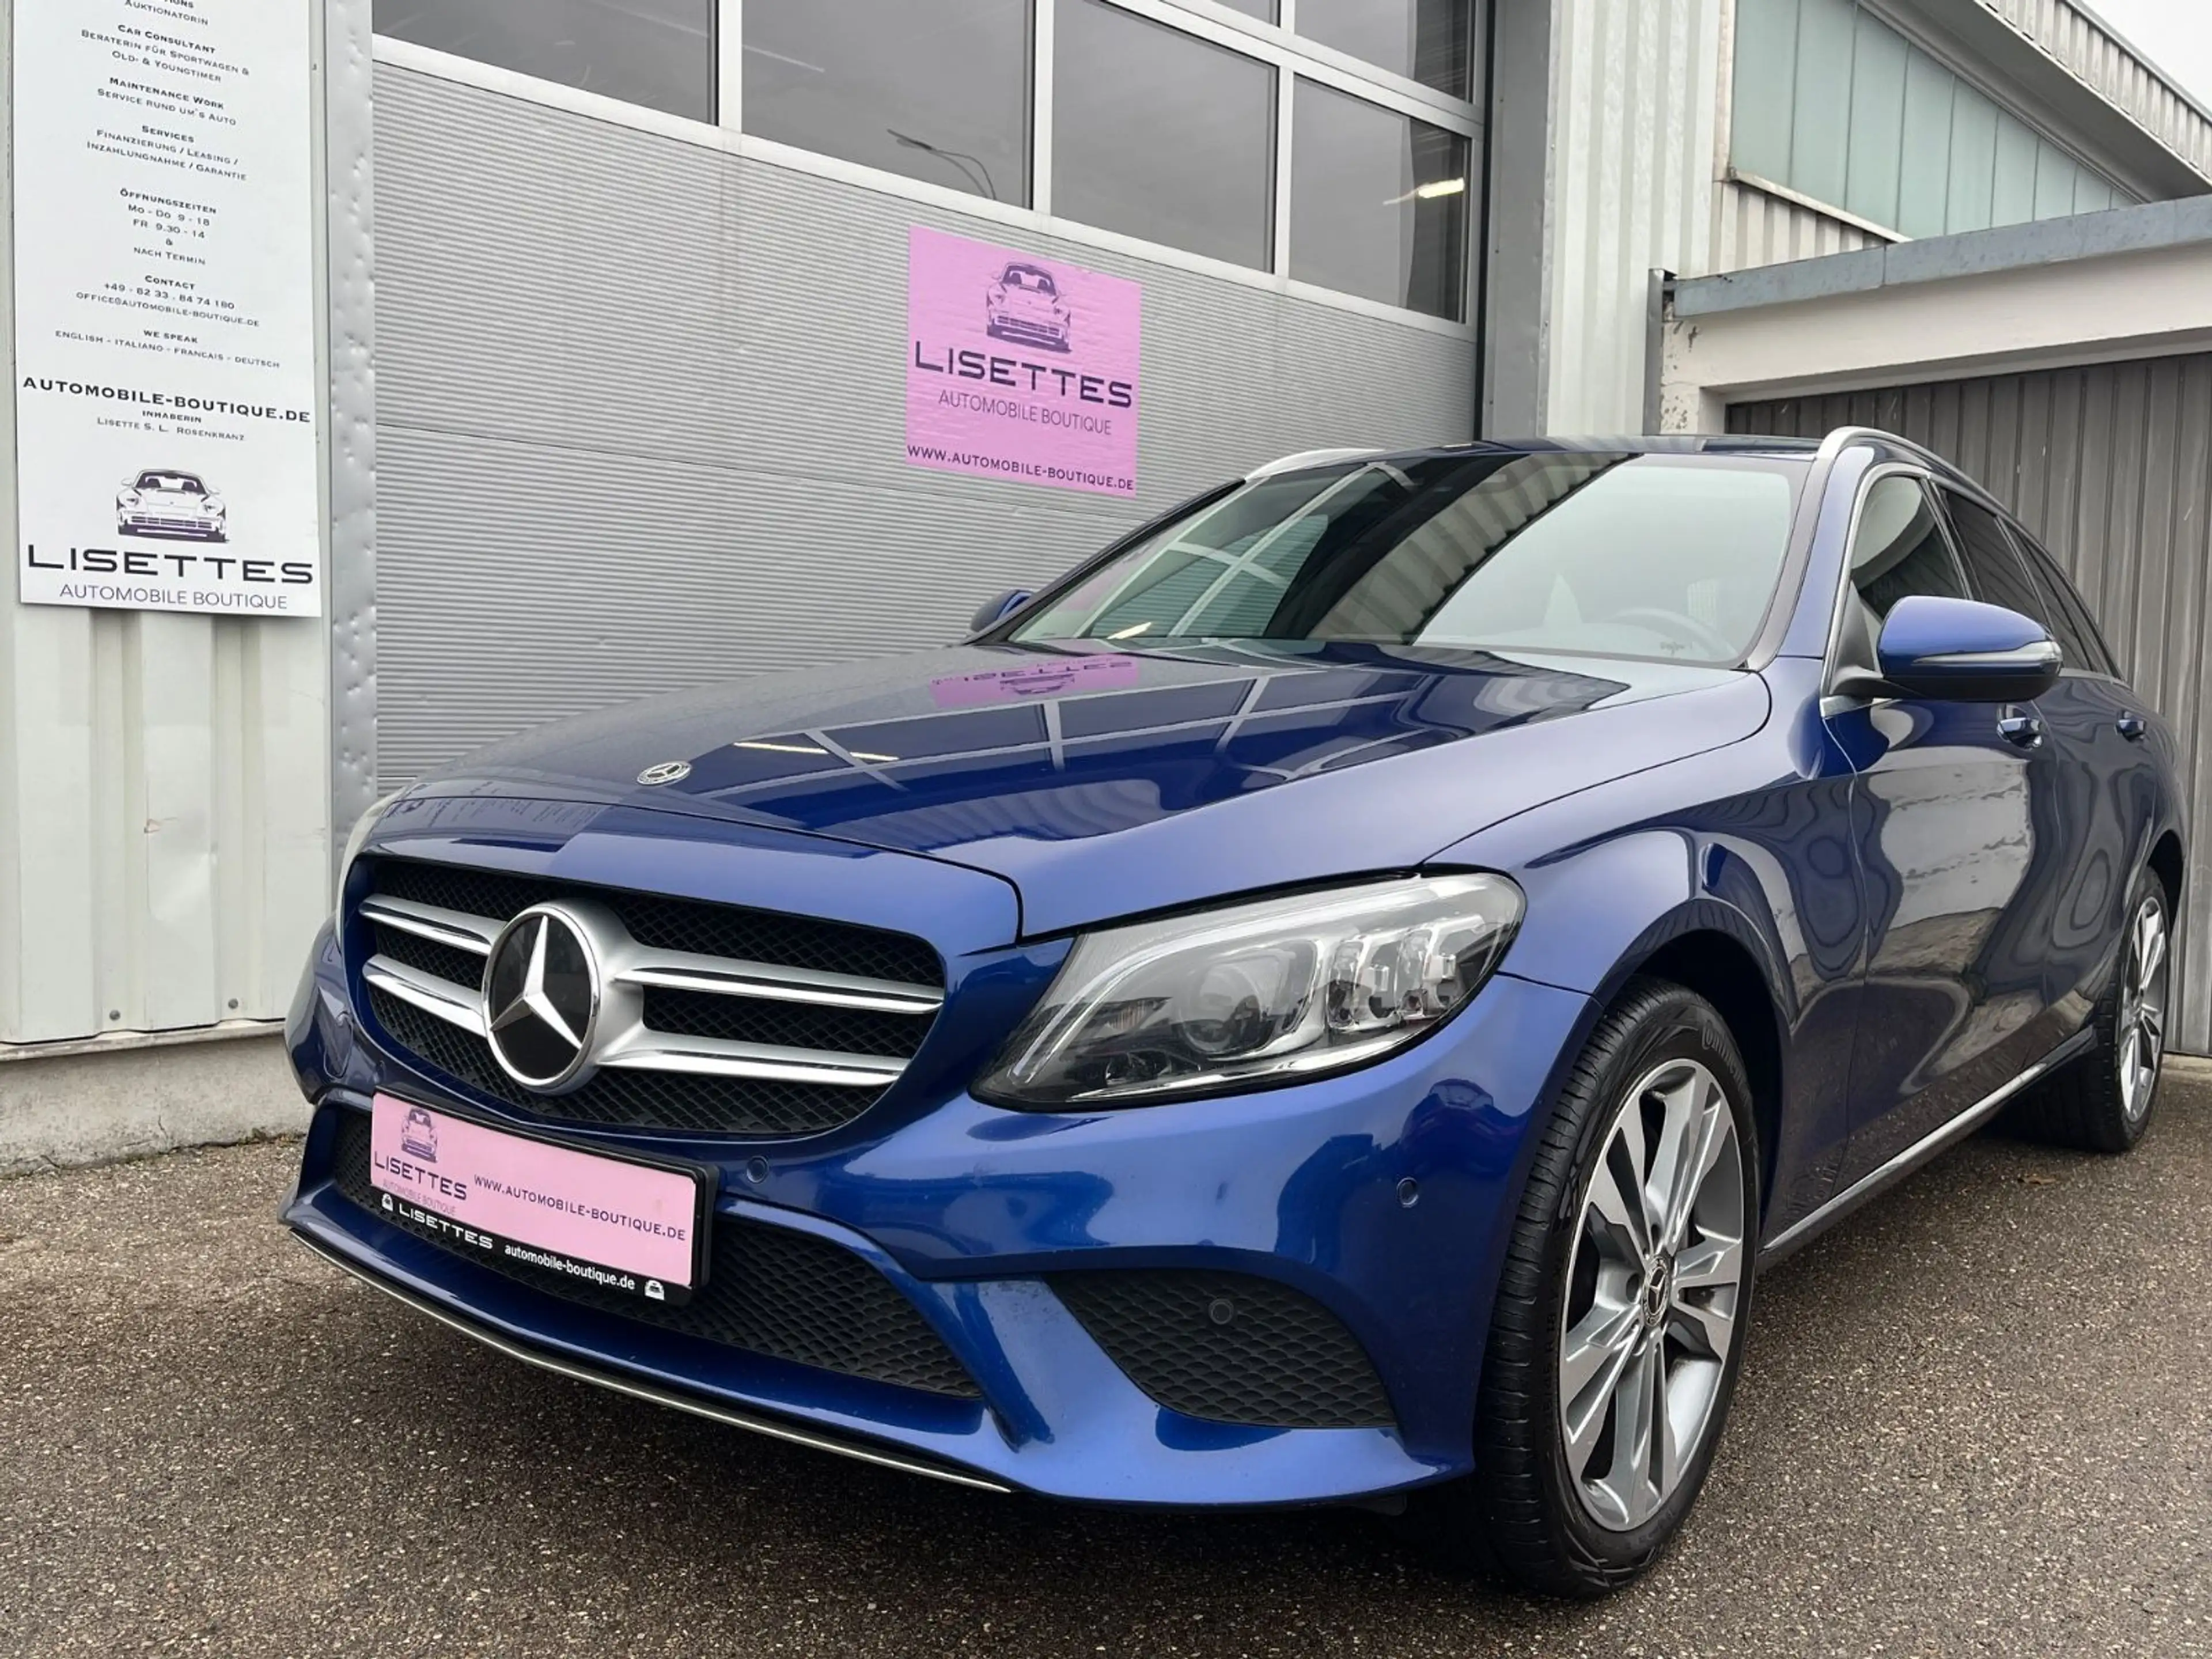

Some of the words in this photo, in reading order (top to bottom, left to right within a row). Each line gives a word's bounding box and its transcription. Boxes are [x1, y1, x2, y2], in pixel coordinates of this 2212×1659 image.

[165, 0, 194, 9] IONS
[142, 57, 150, 66] &
[192, 230, 204, 238] 14
[198, 217, 210, 226] 18
[166, 238, 173, 246] &
[145, 275, 195, 290] CONTACT
[155, 290, 168, 299] 33
[196, 297, 210, 306] 74
[55, 331, 103, 343] ENGLISH
[115, 339, 164, 352] ITALIANO
[235, 357, 279, 368] DEUTSCH
[143, 329, 160, 338] WE
[164, 333, 198, 343] SPEAK
[915, 341, 1132, 408] LISETTES
[23, 377, 310, 423] AUTOMOBILE-BOUTIQUE.DE
[938, 390, 1037, 422] AUTOMOBILE
[1042, 409, 1112, 435] BOUTIQUE
[142, 410, 201, 423] INHABERIN
[908, 445, 1134, 490] WWW.AUTOMOBILE-BOUTIQUE.DE
[28, 544, 313, 584] LISETTES
[59, 584, 187, 604] AUTOMOBILE
[194, 592, 287, 609] BOUTIQUE
[374, 1152, 467, 1200] LISETTES
[475, 1173, 685, 1241] WWW.AUTOMOBILE-BOUTIQUE.DE
[399, 1203, 493, 1249] LISETTES
[505, 1244, 635, 1290] automobile-boutique.de
